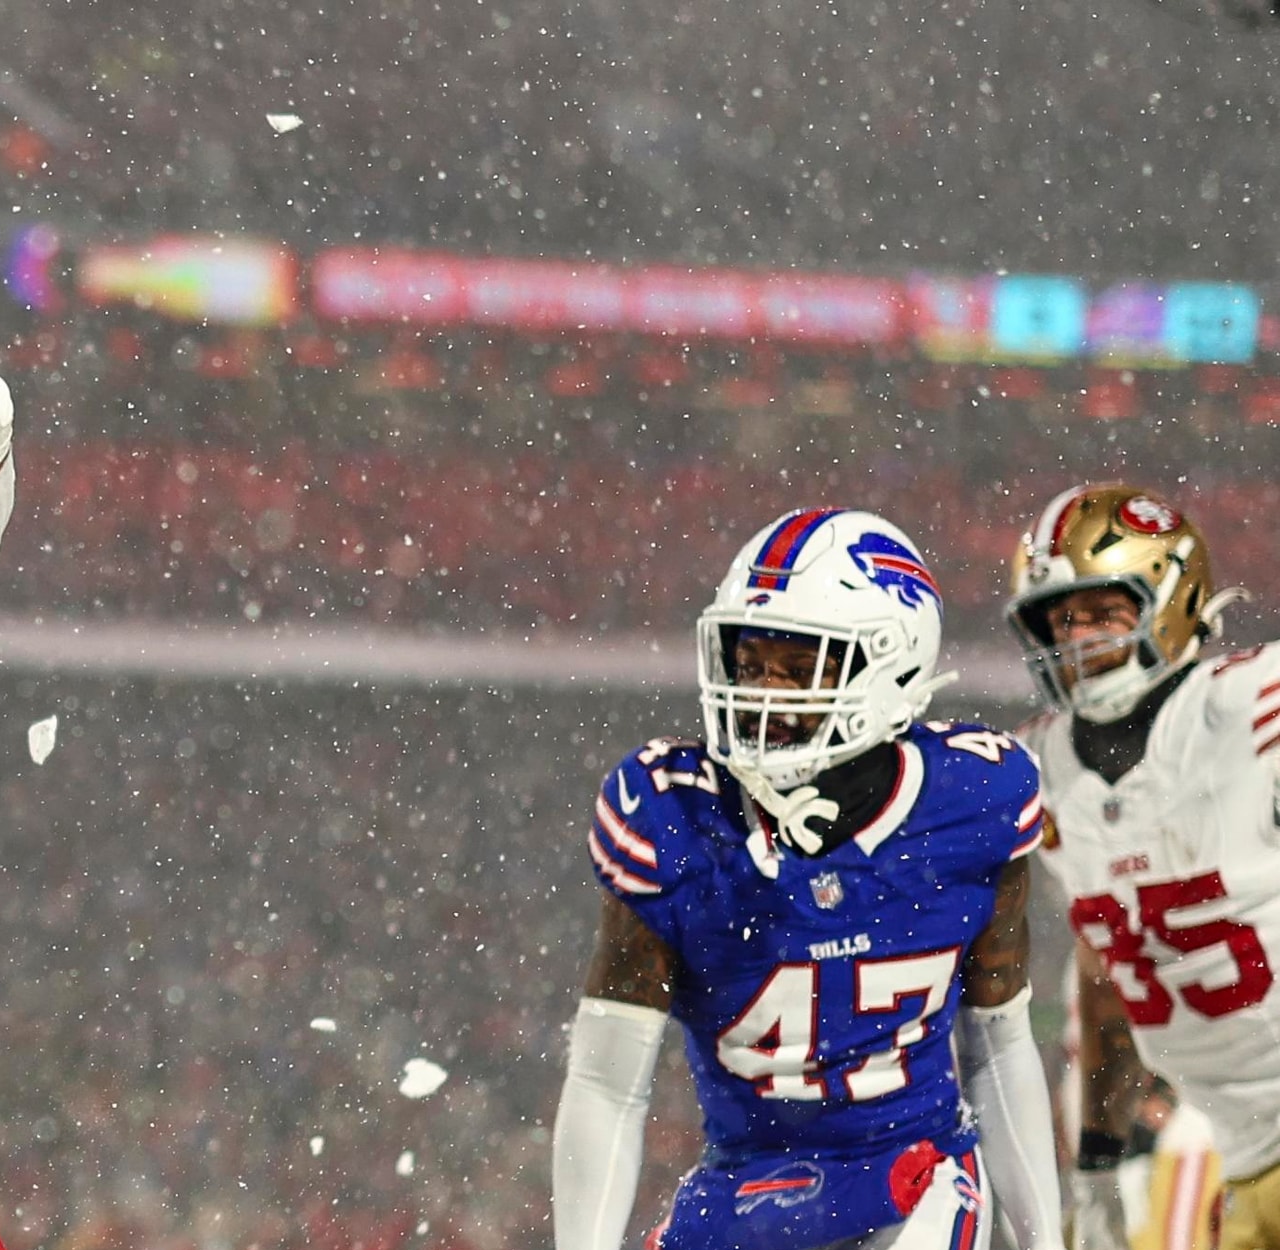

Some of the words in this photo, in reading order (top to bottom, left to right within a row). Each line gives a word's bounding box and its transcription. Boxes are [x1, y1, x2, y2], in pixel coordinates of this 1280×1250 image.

[716, 945, 963, 1102] 47
[808, 932, 872, 961] BILLS
[1069, 870, 1275, 1027] 85
